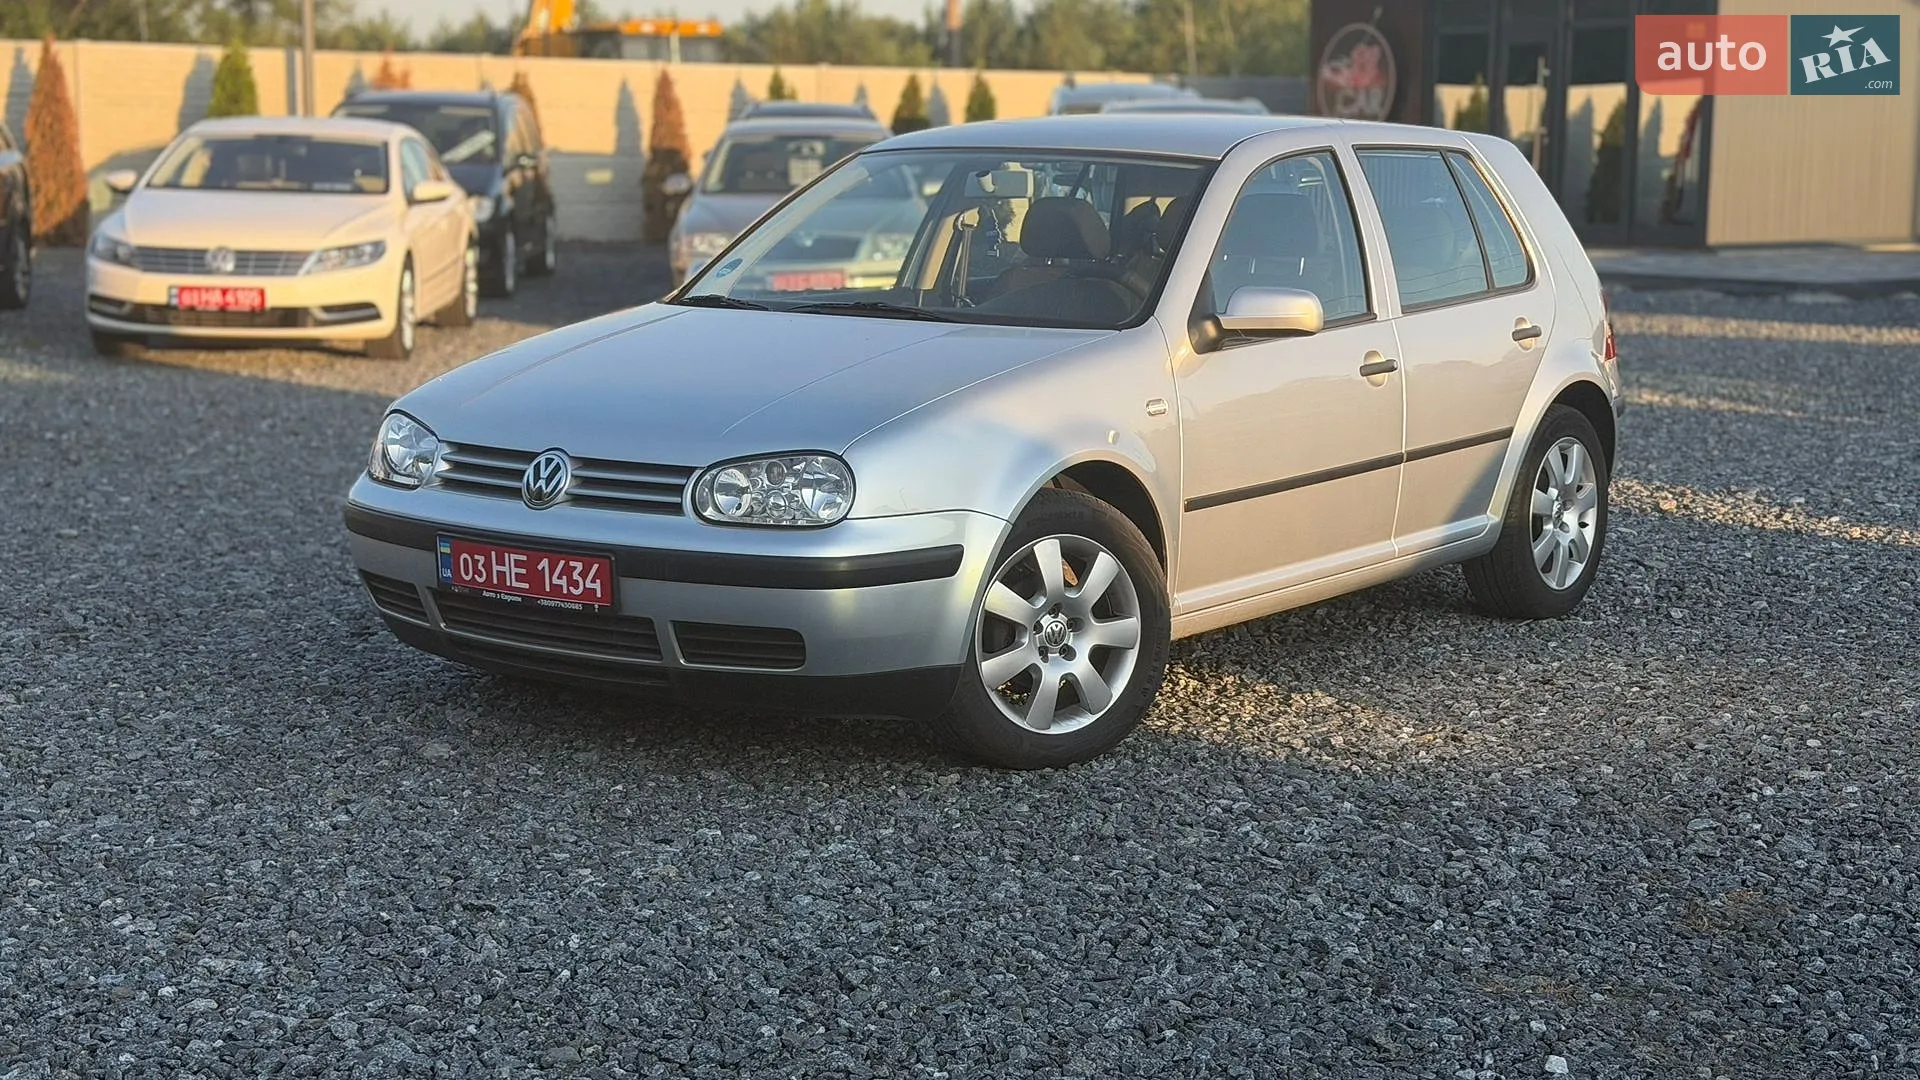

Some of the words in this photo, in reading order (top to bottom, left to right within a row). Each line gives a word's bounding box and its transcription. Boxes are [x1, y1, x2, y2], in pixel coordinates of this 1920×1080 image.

[442, 567, 452, 577] UA
[459, 552, 488, 583] 03
[491, 551, 530, 589] HE
[537, 557, 601, 598] 1434
